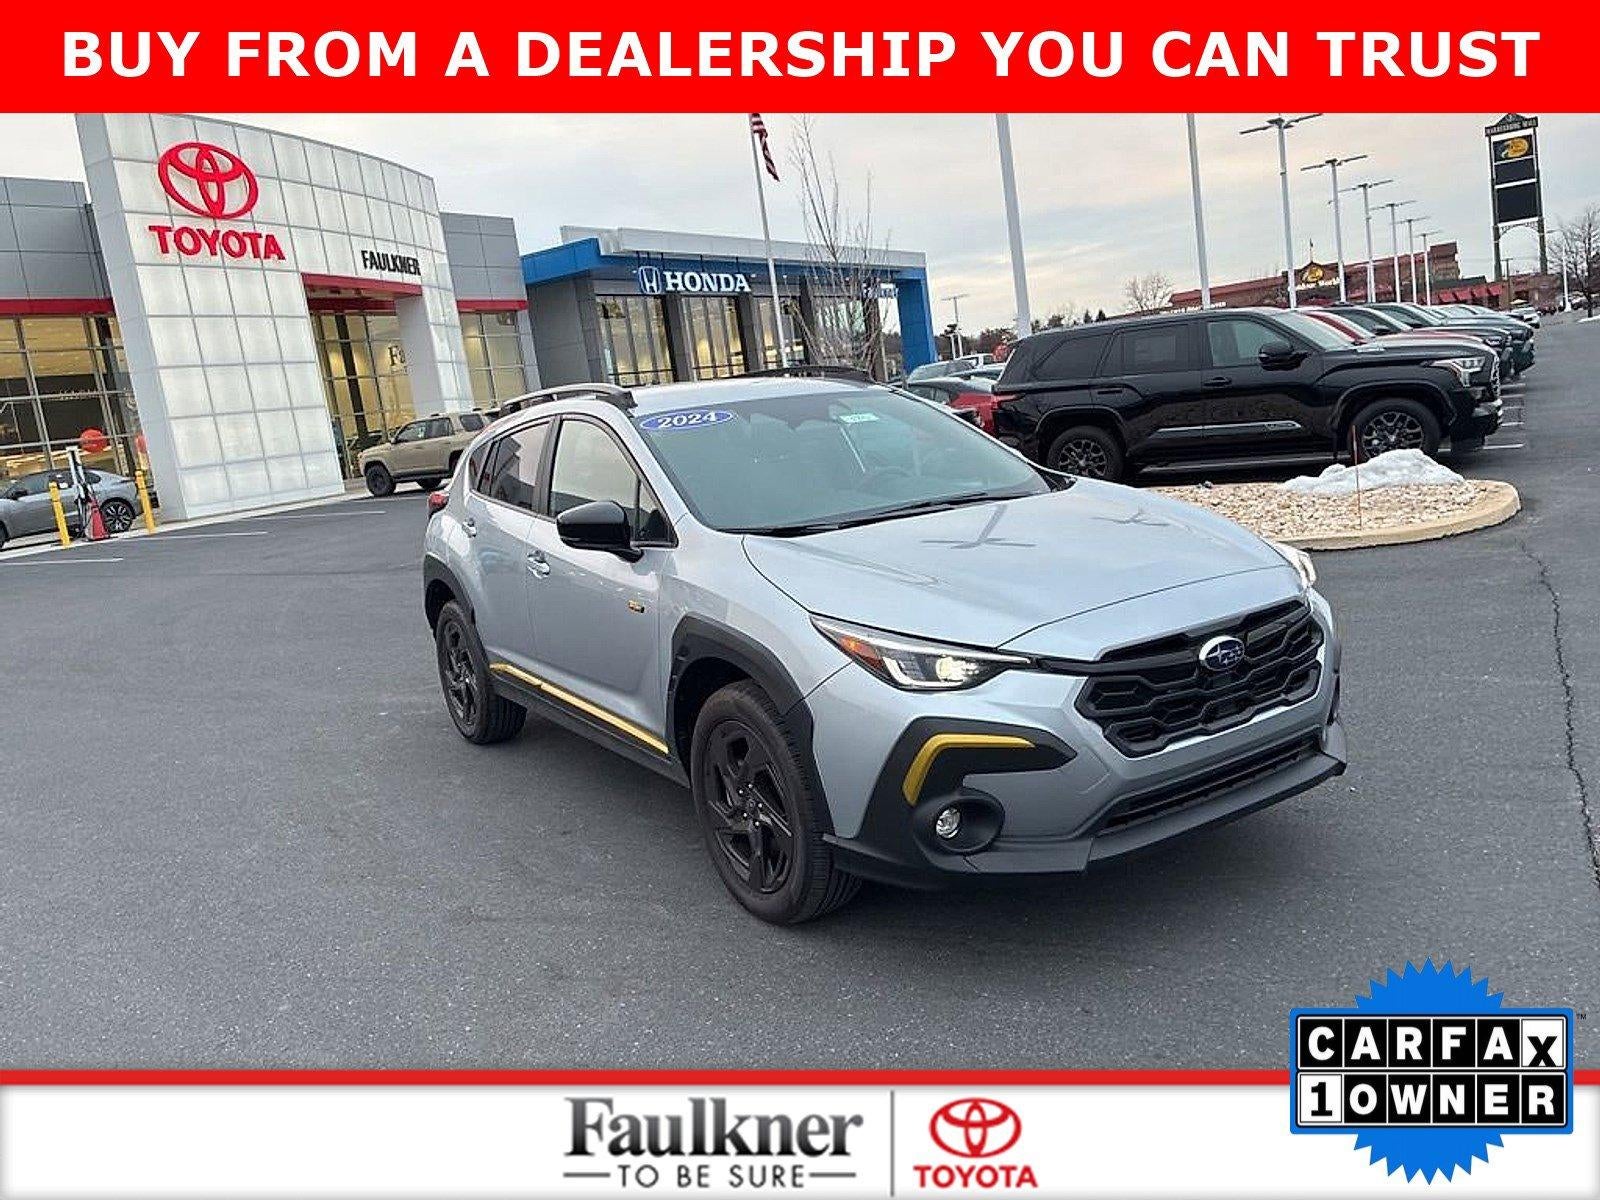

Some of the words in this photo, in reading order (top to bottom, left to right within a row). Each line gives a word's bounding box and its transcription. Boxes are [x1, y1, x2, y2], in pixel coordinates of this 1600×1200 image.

[148, 225, 286, 260] TOYOTA
[361, 250, 422, 276] FAULKNER
[662, 271, 751, 292] HONDA
[658, 411, 716, 428] 2024
